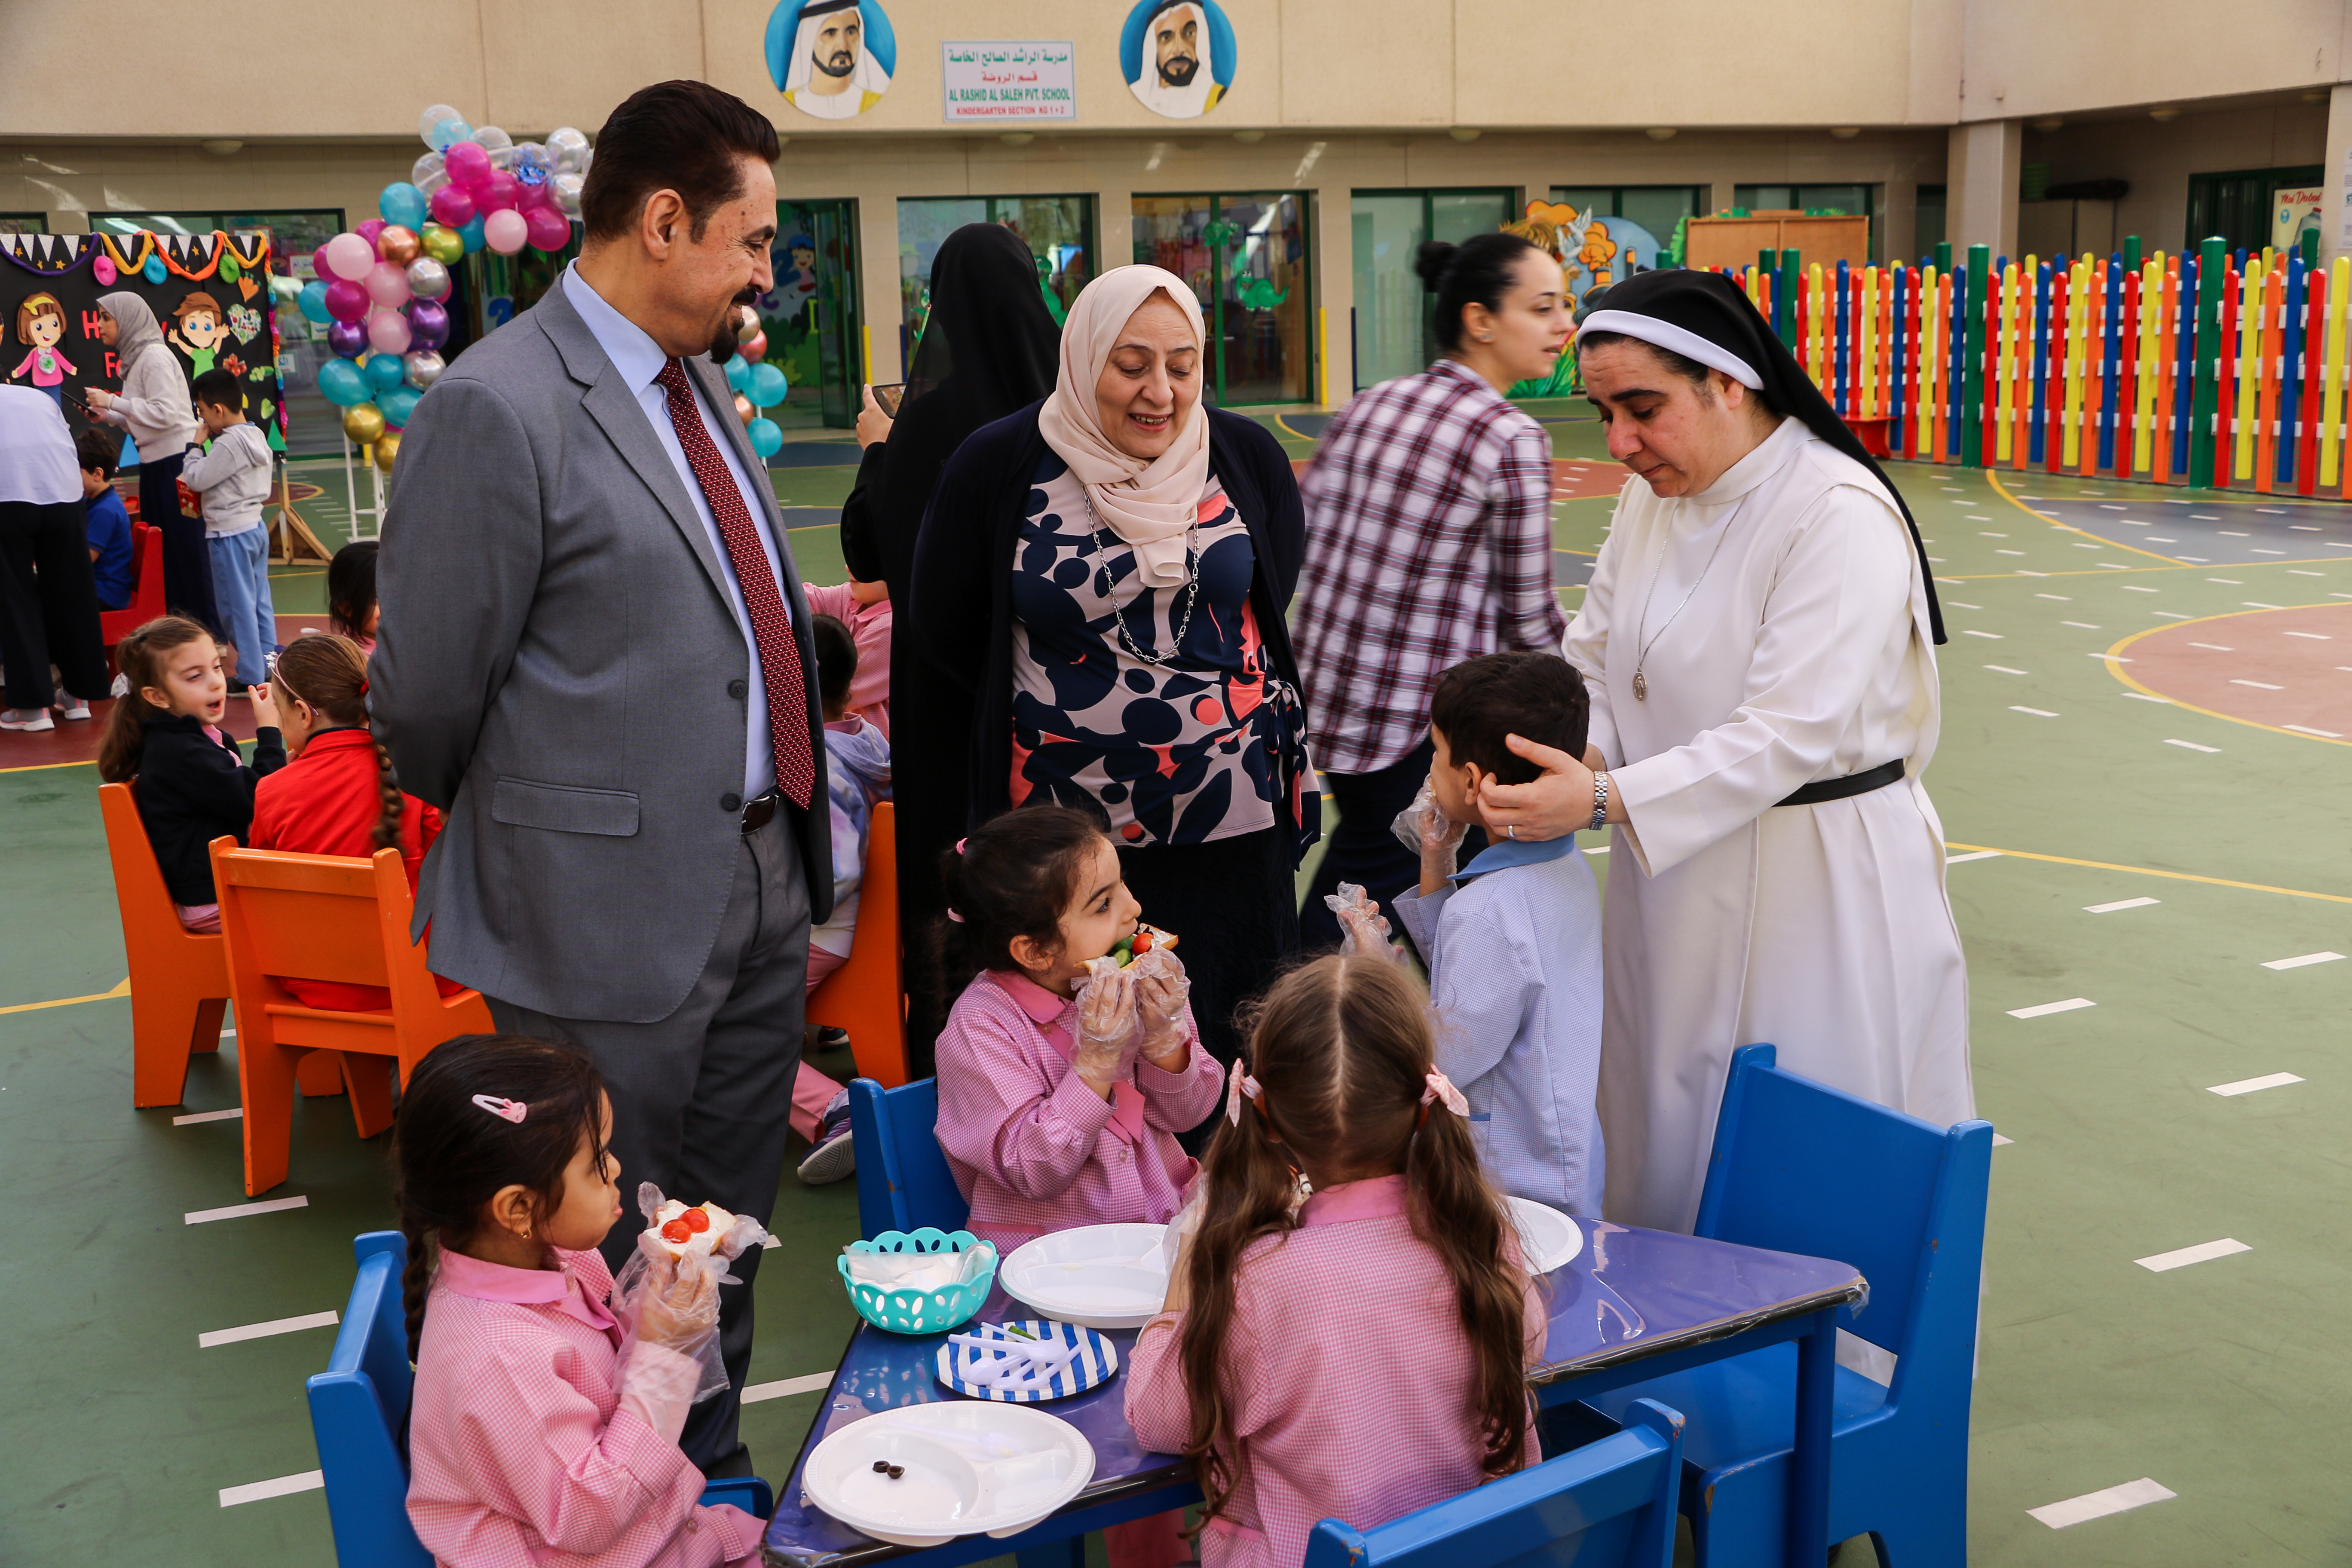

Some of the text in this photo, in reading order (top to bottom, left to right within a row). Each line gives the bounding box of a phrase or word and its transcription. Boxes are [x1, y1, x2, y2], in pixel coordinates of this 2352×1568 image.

[949, 47, 1067, 66] مدرسة الراشد الصالح الخاصة
[981, 70, 1038, 84] قسم الروضة
[949, 88, 1070, 101] AL RASHID AL SALEH PVT. SCHOOL
[957, 107, 1006, 115] KINDERGARTEN
[1008, 106, 1035, 114] SECTION
